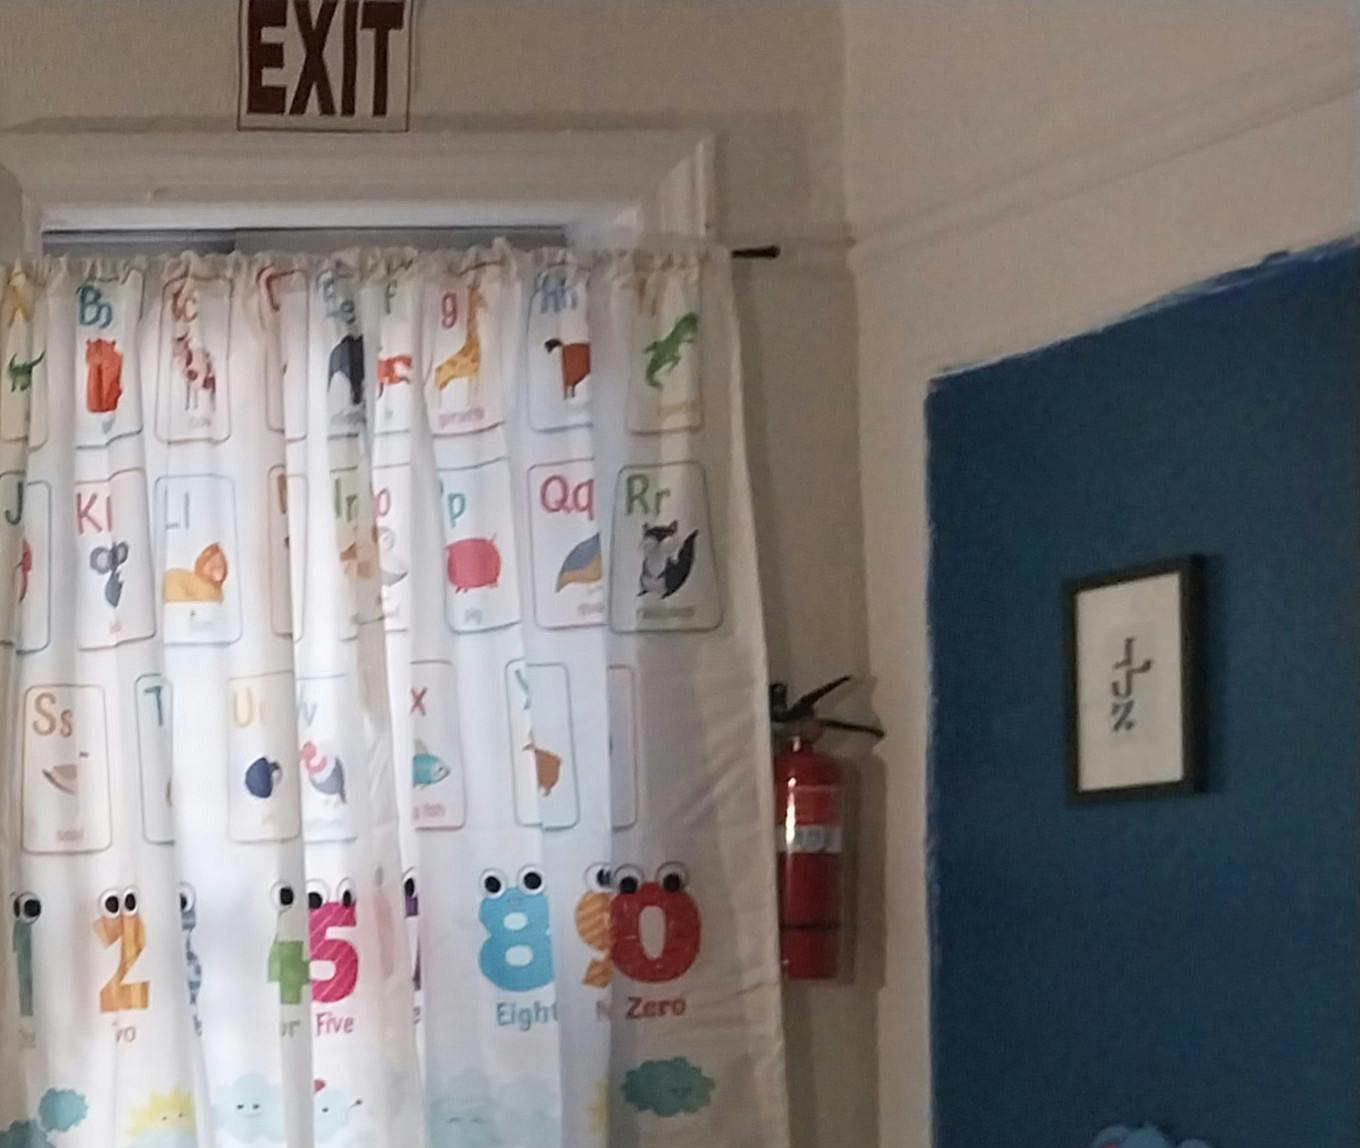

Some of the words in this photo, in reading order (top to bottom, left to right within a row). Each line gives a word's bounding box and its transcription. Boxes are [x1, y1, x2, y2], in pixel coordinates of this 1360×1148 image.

[246, 0, 405, 117] EXIT
[625, 473, 671, 517] Rr
[31, 691, 74, 738] Ss
[92, 913, 152, 1014] 2
[307, 898, 360, 1004] 5
[478, 884, 556, 992] 8
[609, 880, 703, 985] 0
[316, 1011, 354, 1037] Five
[625, 995, 687, 1021] Zero
